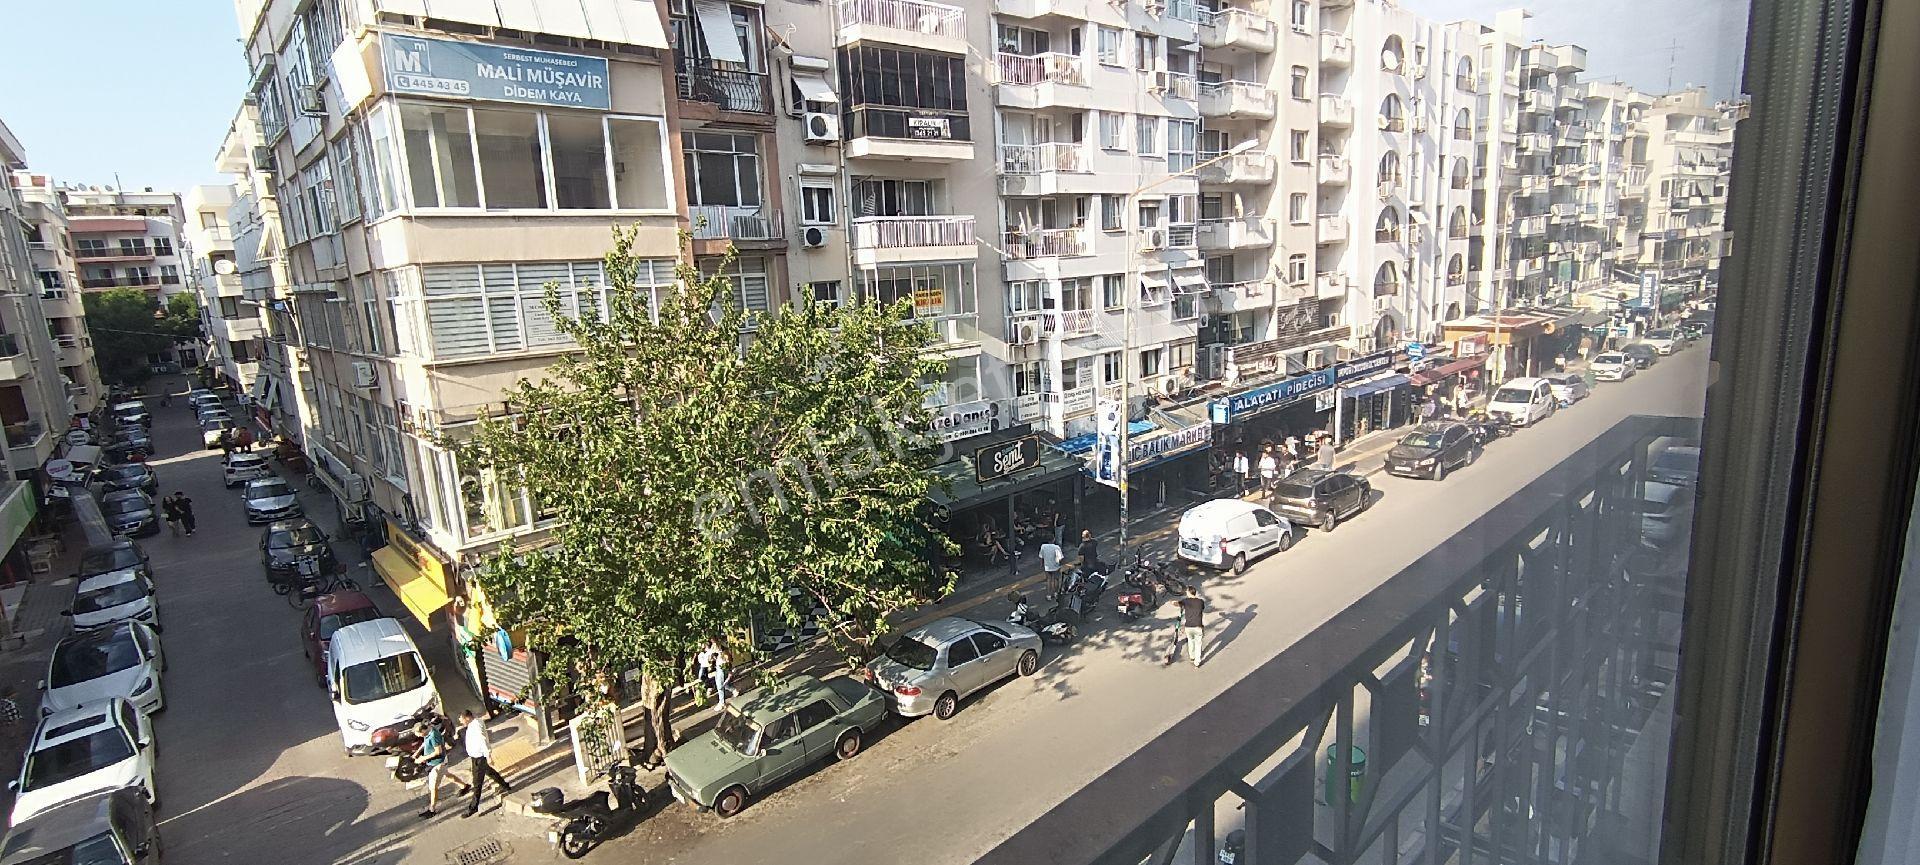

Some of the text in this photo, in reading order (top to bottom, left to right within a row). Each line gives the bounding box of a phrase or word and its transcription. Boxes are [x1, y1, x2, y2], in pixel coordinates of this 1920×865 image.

[394, 49, 422, 73] M
[503, 53, 532, 63] SERBEST
[412, 79, 467, 92] 445 43 45
[477, 62, 603, 90] MALİ MÜŞAVİR
[503, 85, 582, 103] DİDEM KAYA
[1236, 374, 1326, 411] ALAÇATI PİDECİSİ
[994, 440, 1024, 473] Semt
[1142, 437, 1169, 458] BALIK
